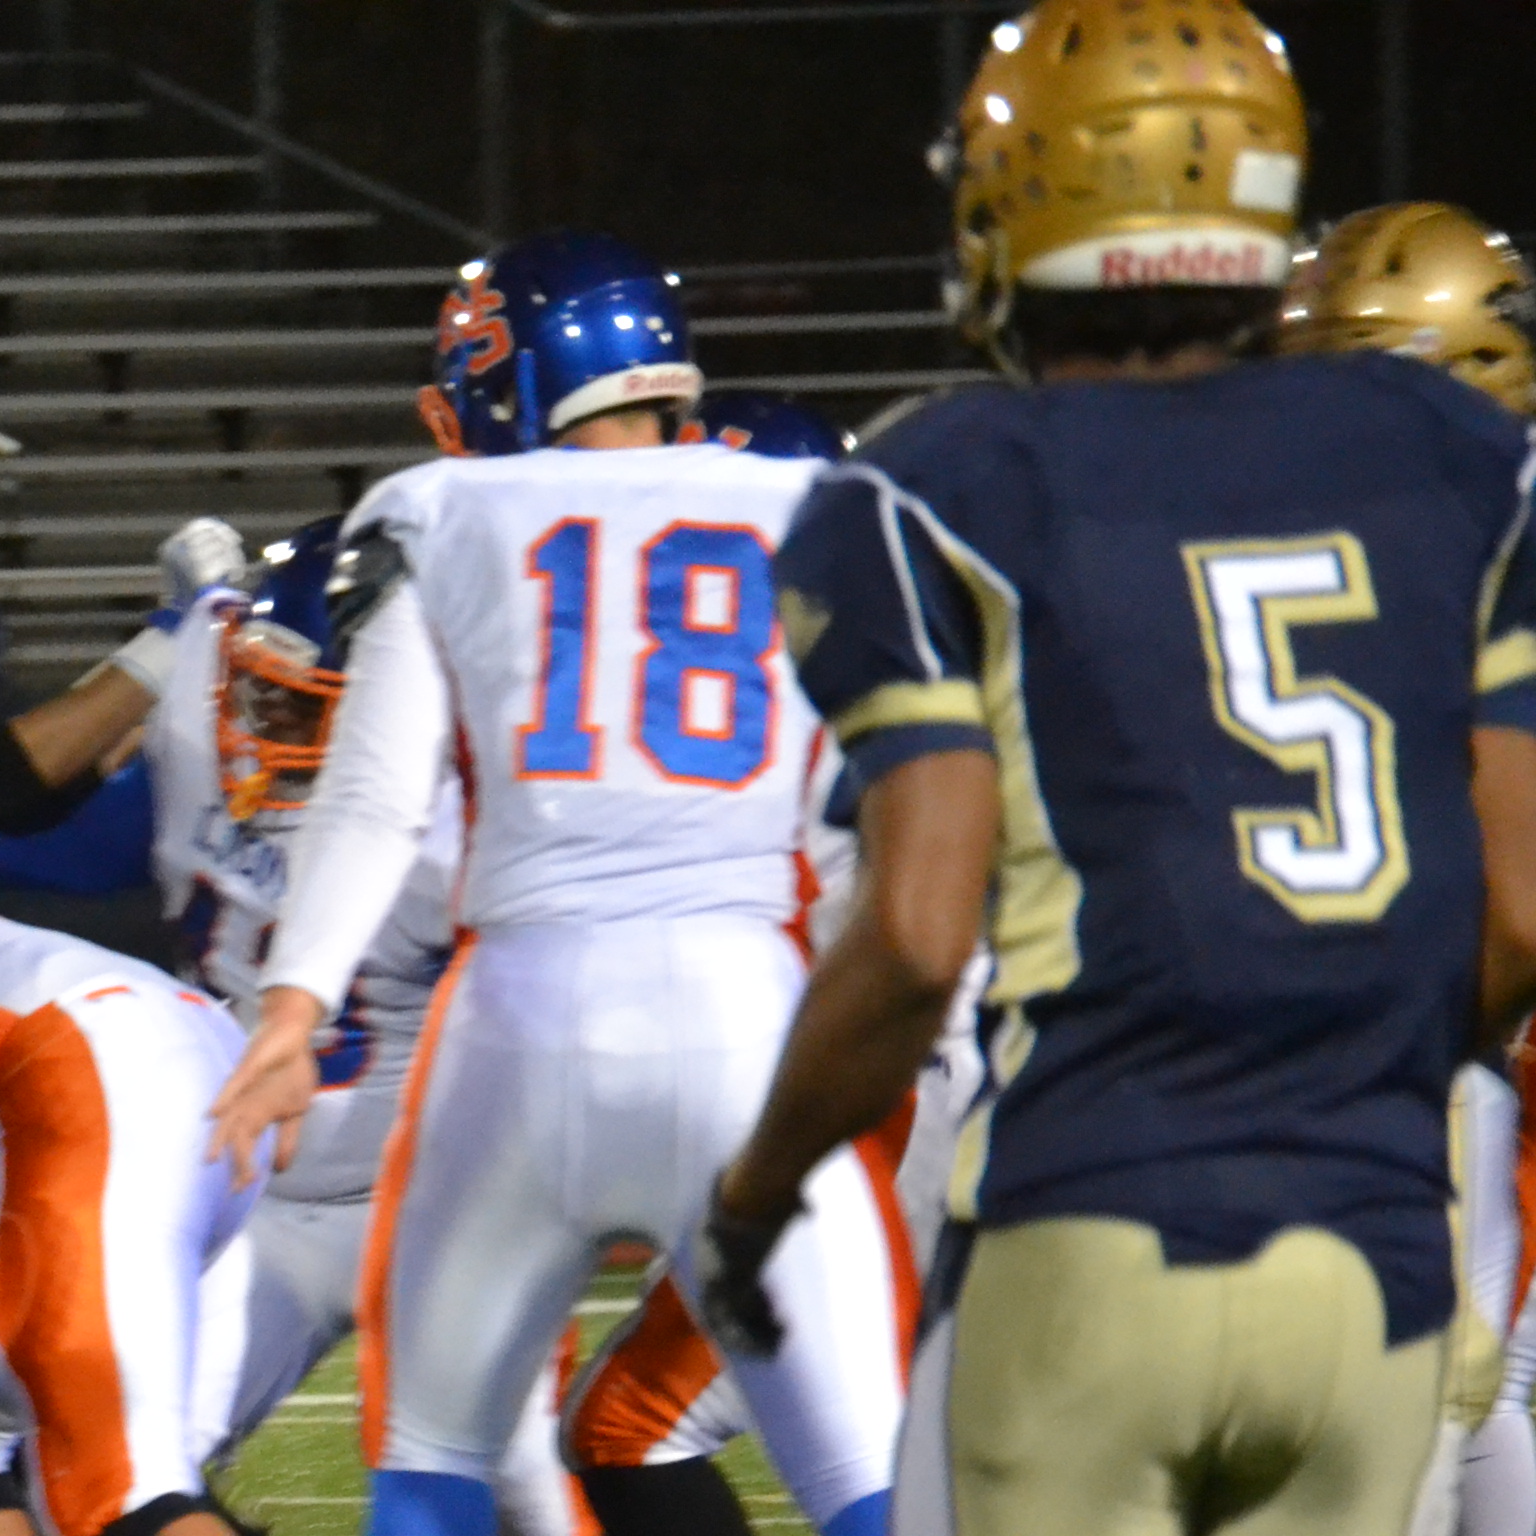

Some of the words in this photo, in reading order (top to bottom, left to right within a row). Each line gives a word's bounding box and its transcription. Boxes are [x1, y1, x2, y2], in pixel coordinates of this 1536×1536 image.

[1100, 242, 1265, 286] Riddell
[512, 514, 784, 792] 18
[1180, 529, 1412, 924] 5
